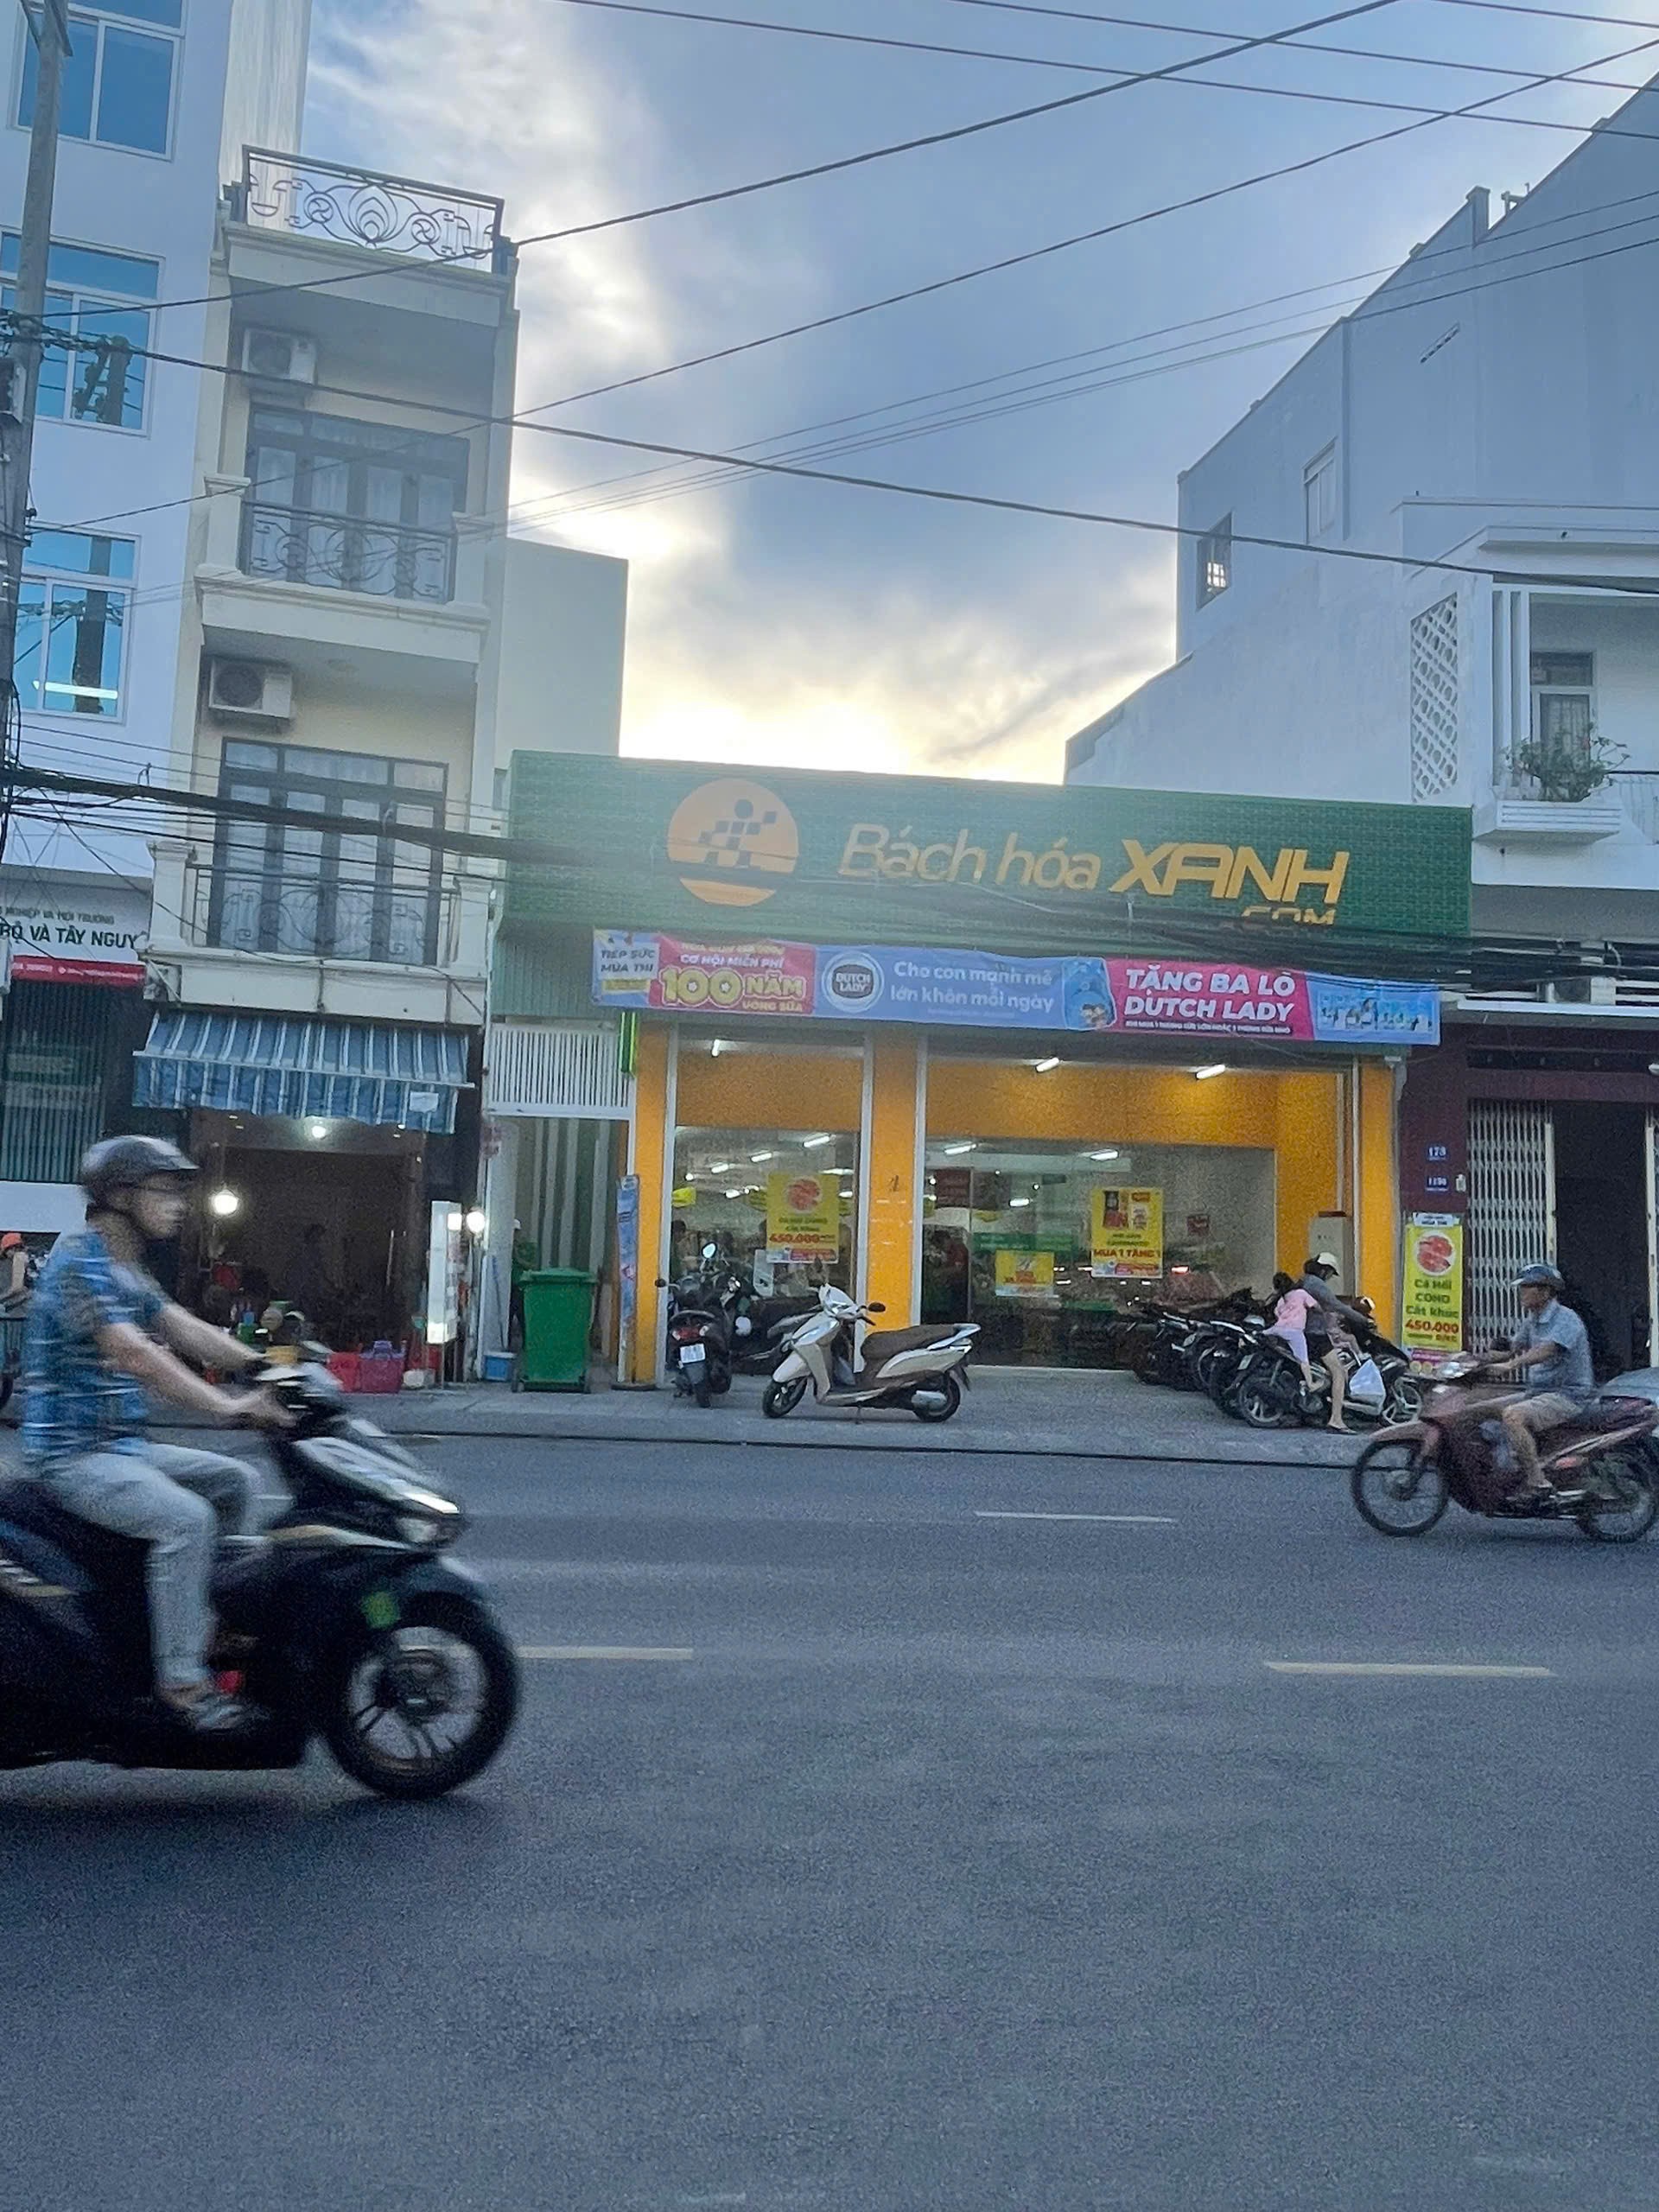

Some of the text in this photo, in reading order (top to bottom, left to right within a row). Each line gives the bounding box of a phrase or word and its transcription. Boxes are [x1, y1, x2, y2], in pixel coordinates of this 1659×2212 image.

[838, 823, 1351, 904] Bách hóa XANH
[29, 922, 51, 943] VÀ
[55, 925, 86, 945] TÂY
[91, 930, 142, 950] NGUY
[660, 966, 744, 1007] 100
[836, 972, 871, 984] DUTCH
[839, 982, 868, 994] LADY
[893, 960, 931, 978] Cho
[933, 966, 968, 982] con
[969, 965, 1023, 990] mạnh
[1125, 963, 1203, 995] TẶNG
[1210, 972, 1250, 995] BA
[890, 984, 918, 1002] lớn
[922, 986, 976, 1006] khôn
[1123, 995, 1295, 1022] DUTCH LADY
[1405, 1319, 1459, 1334] 450.000
